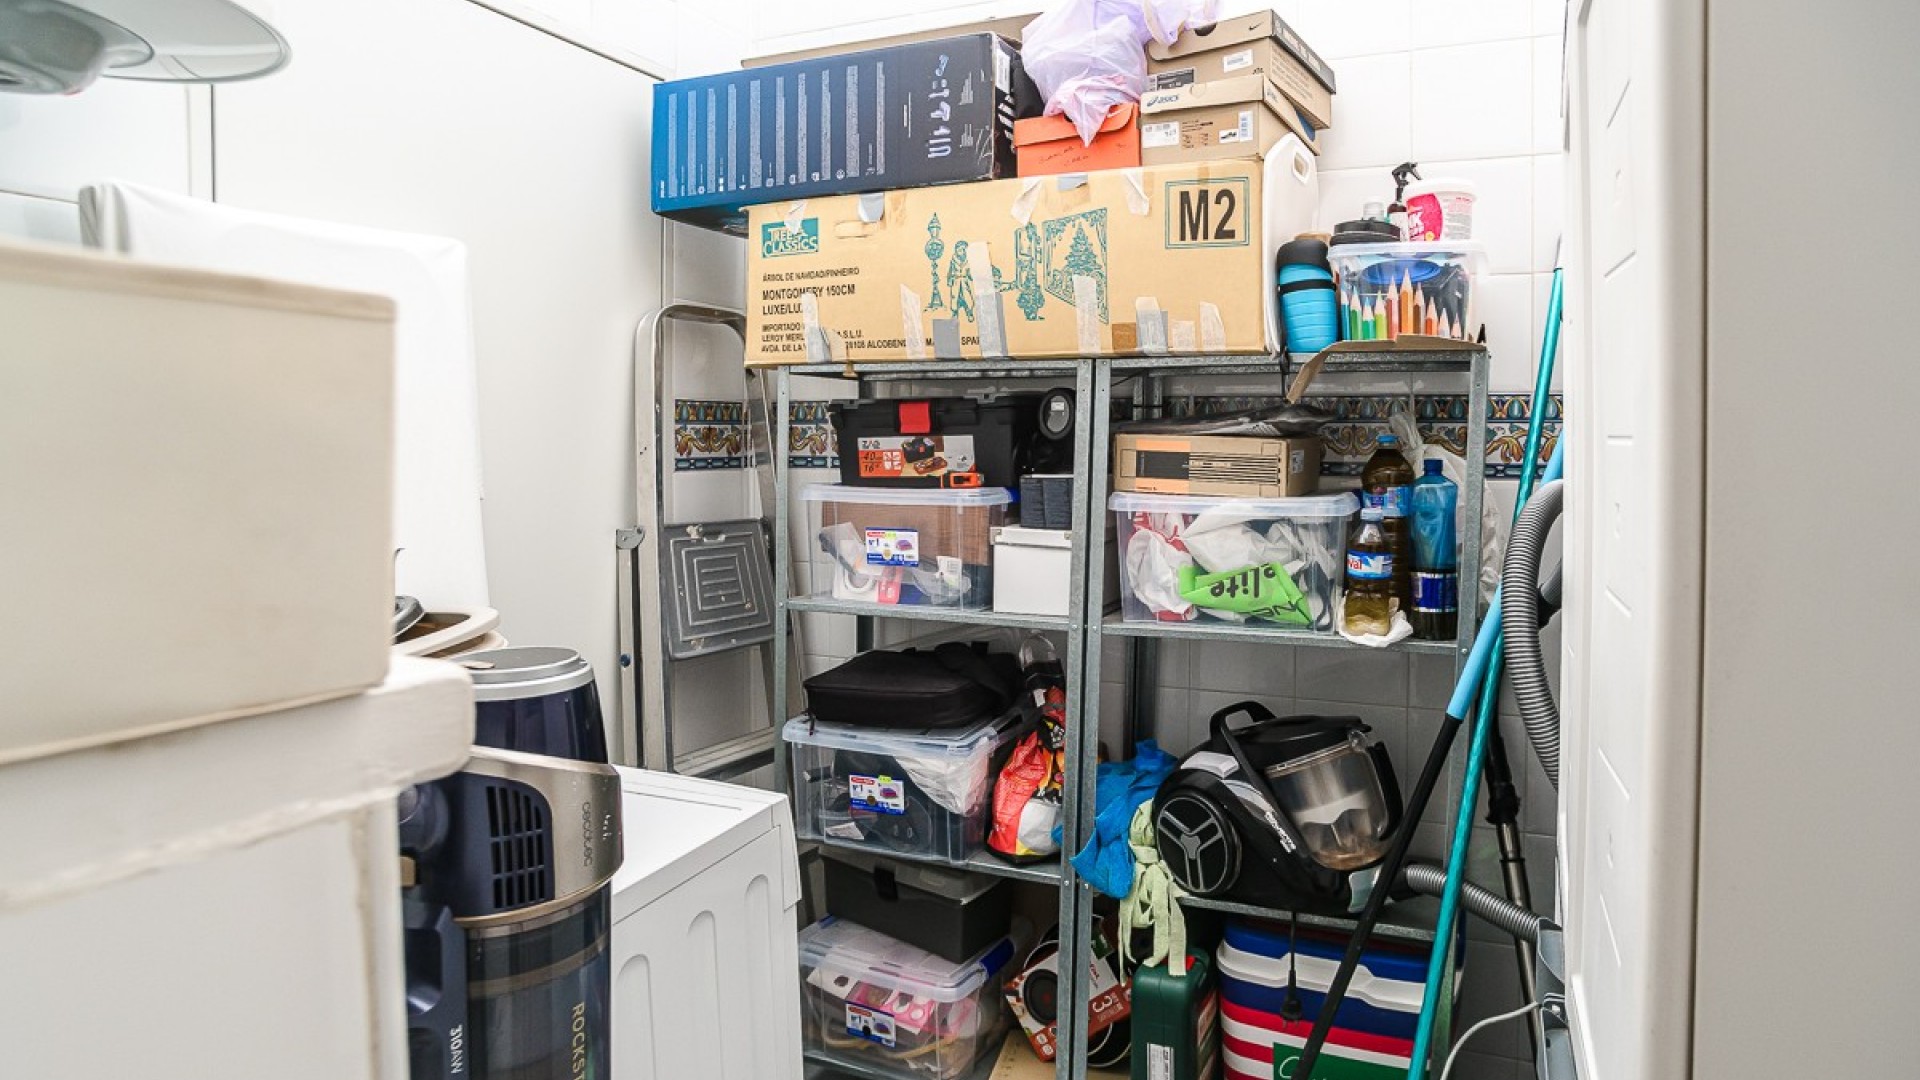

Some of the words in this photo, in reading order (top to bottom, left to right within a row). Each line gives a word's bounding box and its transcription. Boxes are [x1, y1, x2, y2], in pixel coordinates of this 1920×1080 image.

[1179, 188, 1236, 241] M2
[764, 236, 818, 256] CLASSICS
[785, 272, 795, 281] DE
[826, 283, 856, 297] 150CM
[762, 302, 804, 316] LUXE/LU
[762, 322, 801, 333] IMPORTADO
[761, 334, 785, 342] LEROY
[781, 344, 792, 352] DE
